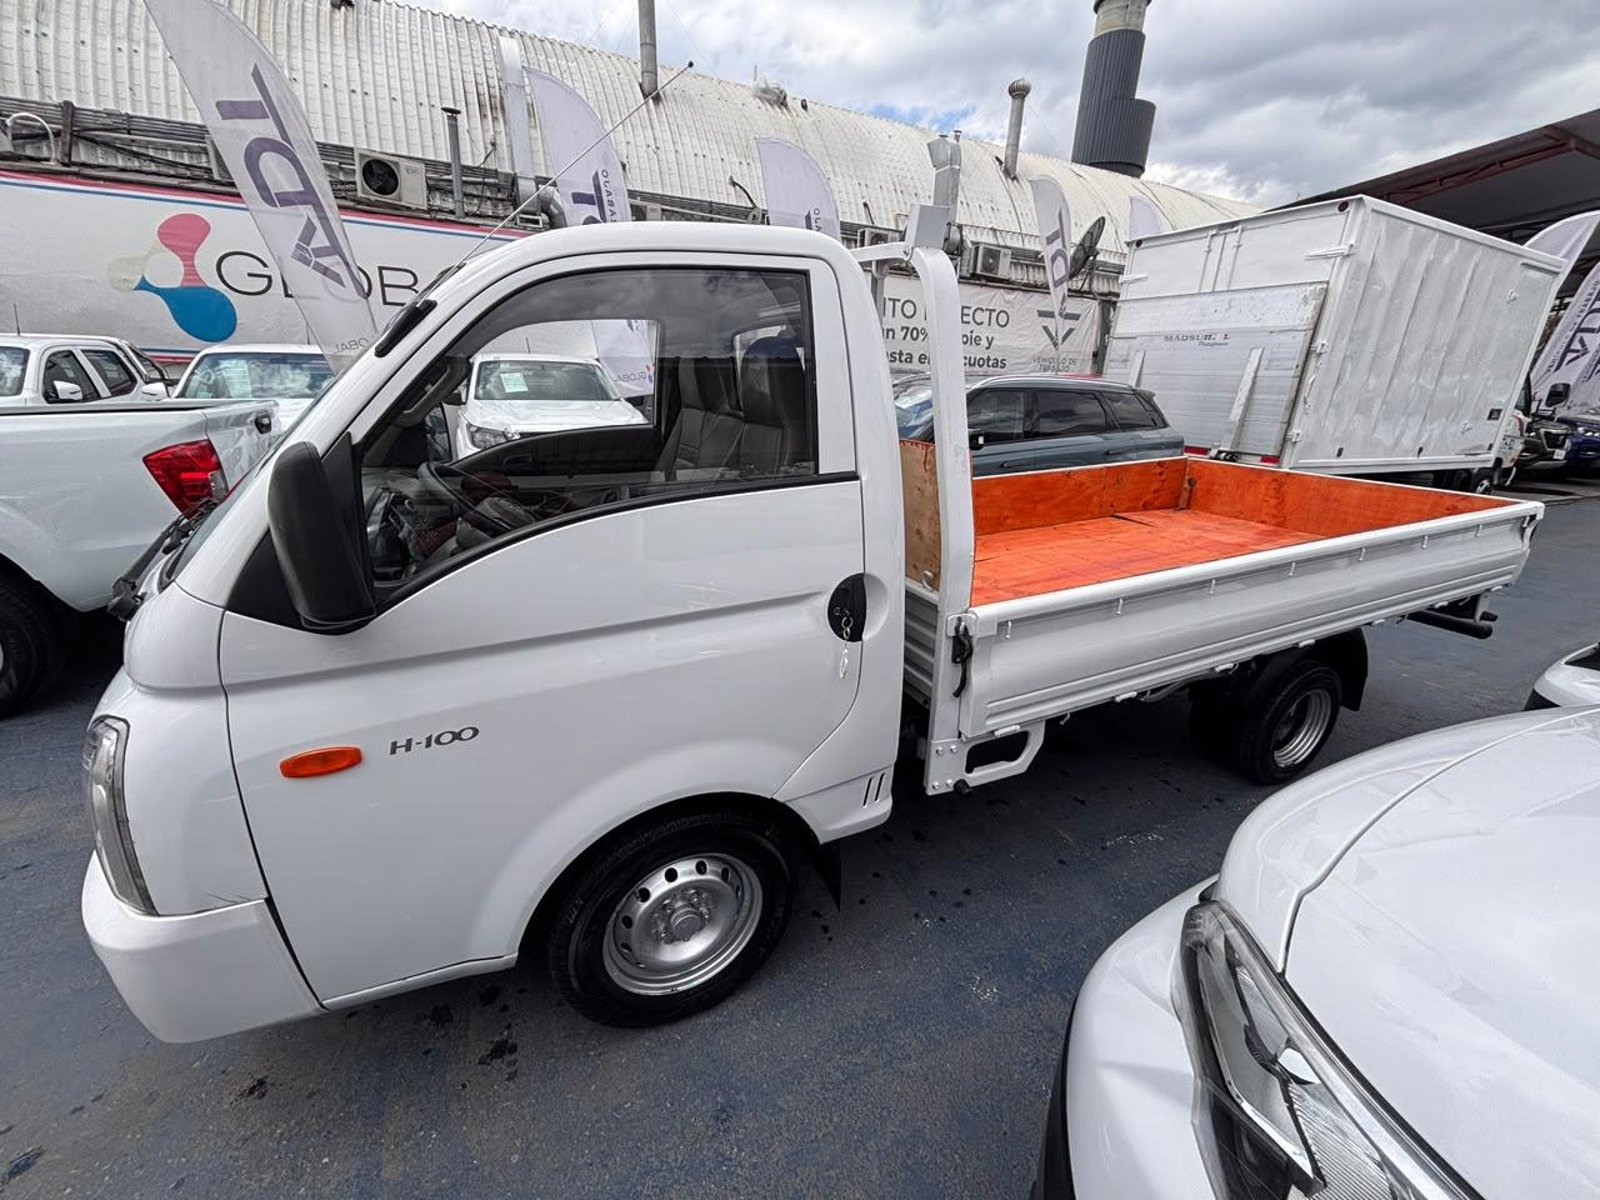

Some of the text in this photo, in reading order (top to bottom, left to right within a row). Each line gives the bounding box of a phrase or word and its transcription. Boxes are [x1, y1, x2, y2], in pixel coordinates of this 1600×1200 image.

[216, 251, 420, 307] GLOB
[960, 305, 1010, 328] ECTO
[985, 336, 995, 350] y
[390, 726, 480, 756] H-100
